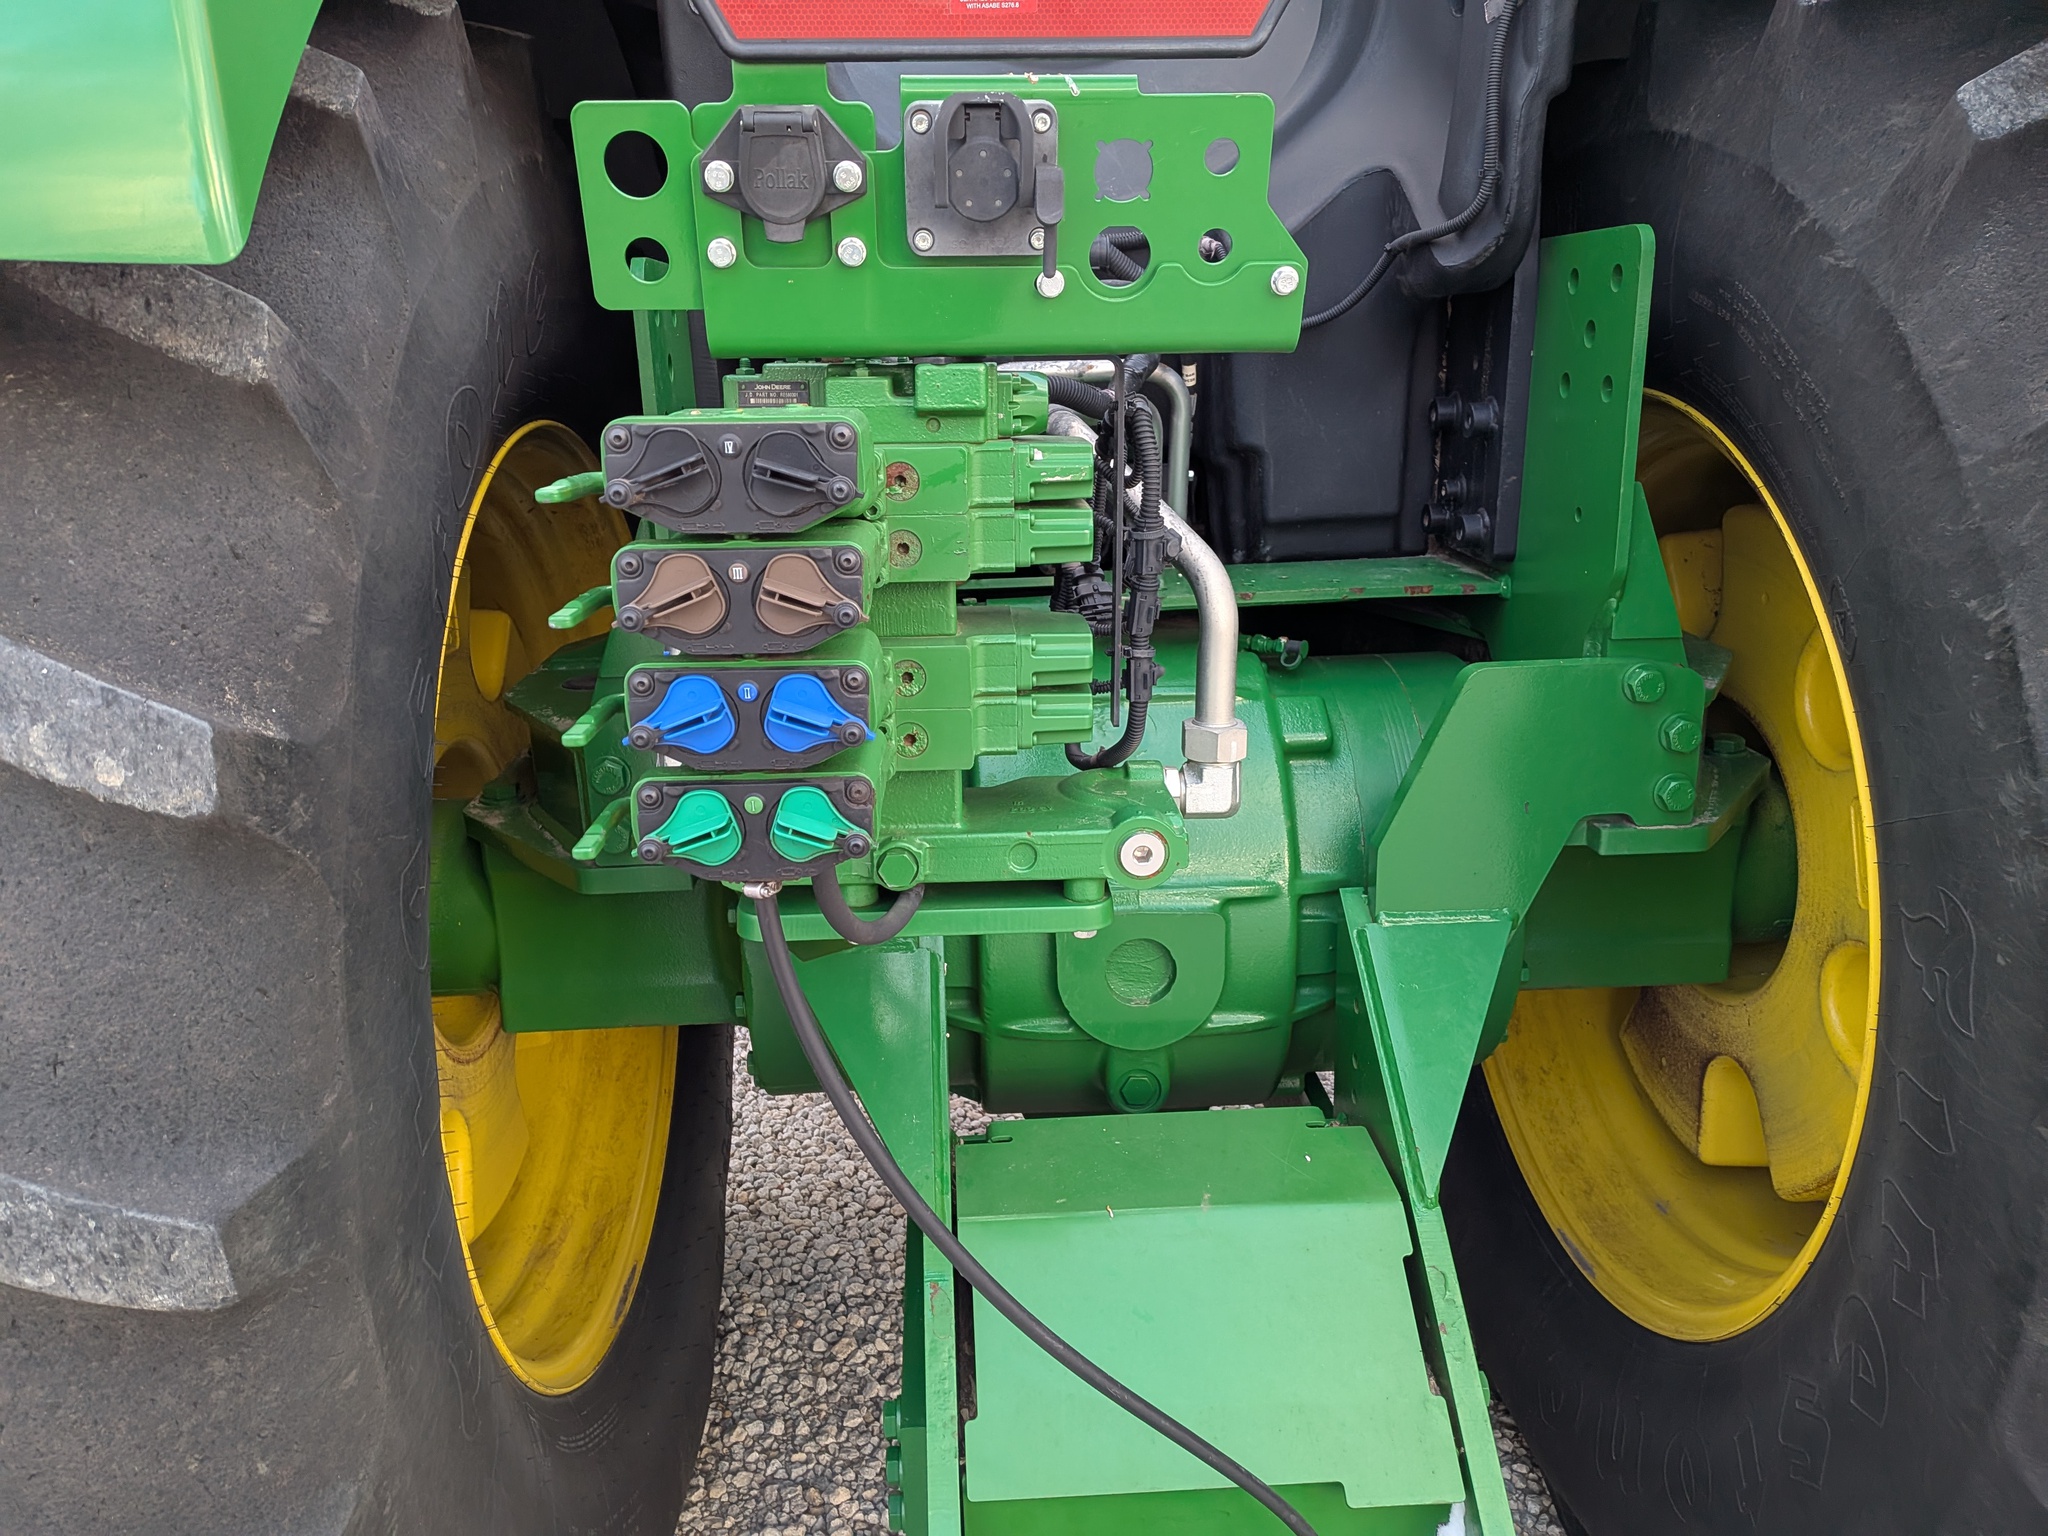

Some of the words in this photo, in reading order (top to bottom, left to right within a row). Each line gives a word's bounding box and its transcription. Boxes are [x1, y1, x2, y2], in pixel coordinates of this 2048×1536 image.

[754, 168, 809, 190] Pollak
[732, 567, 743, 580] III
[744, 688, 751, 699] II
